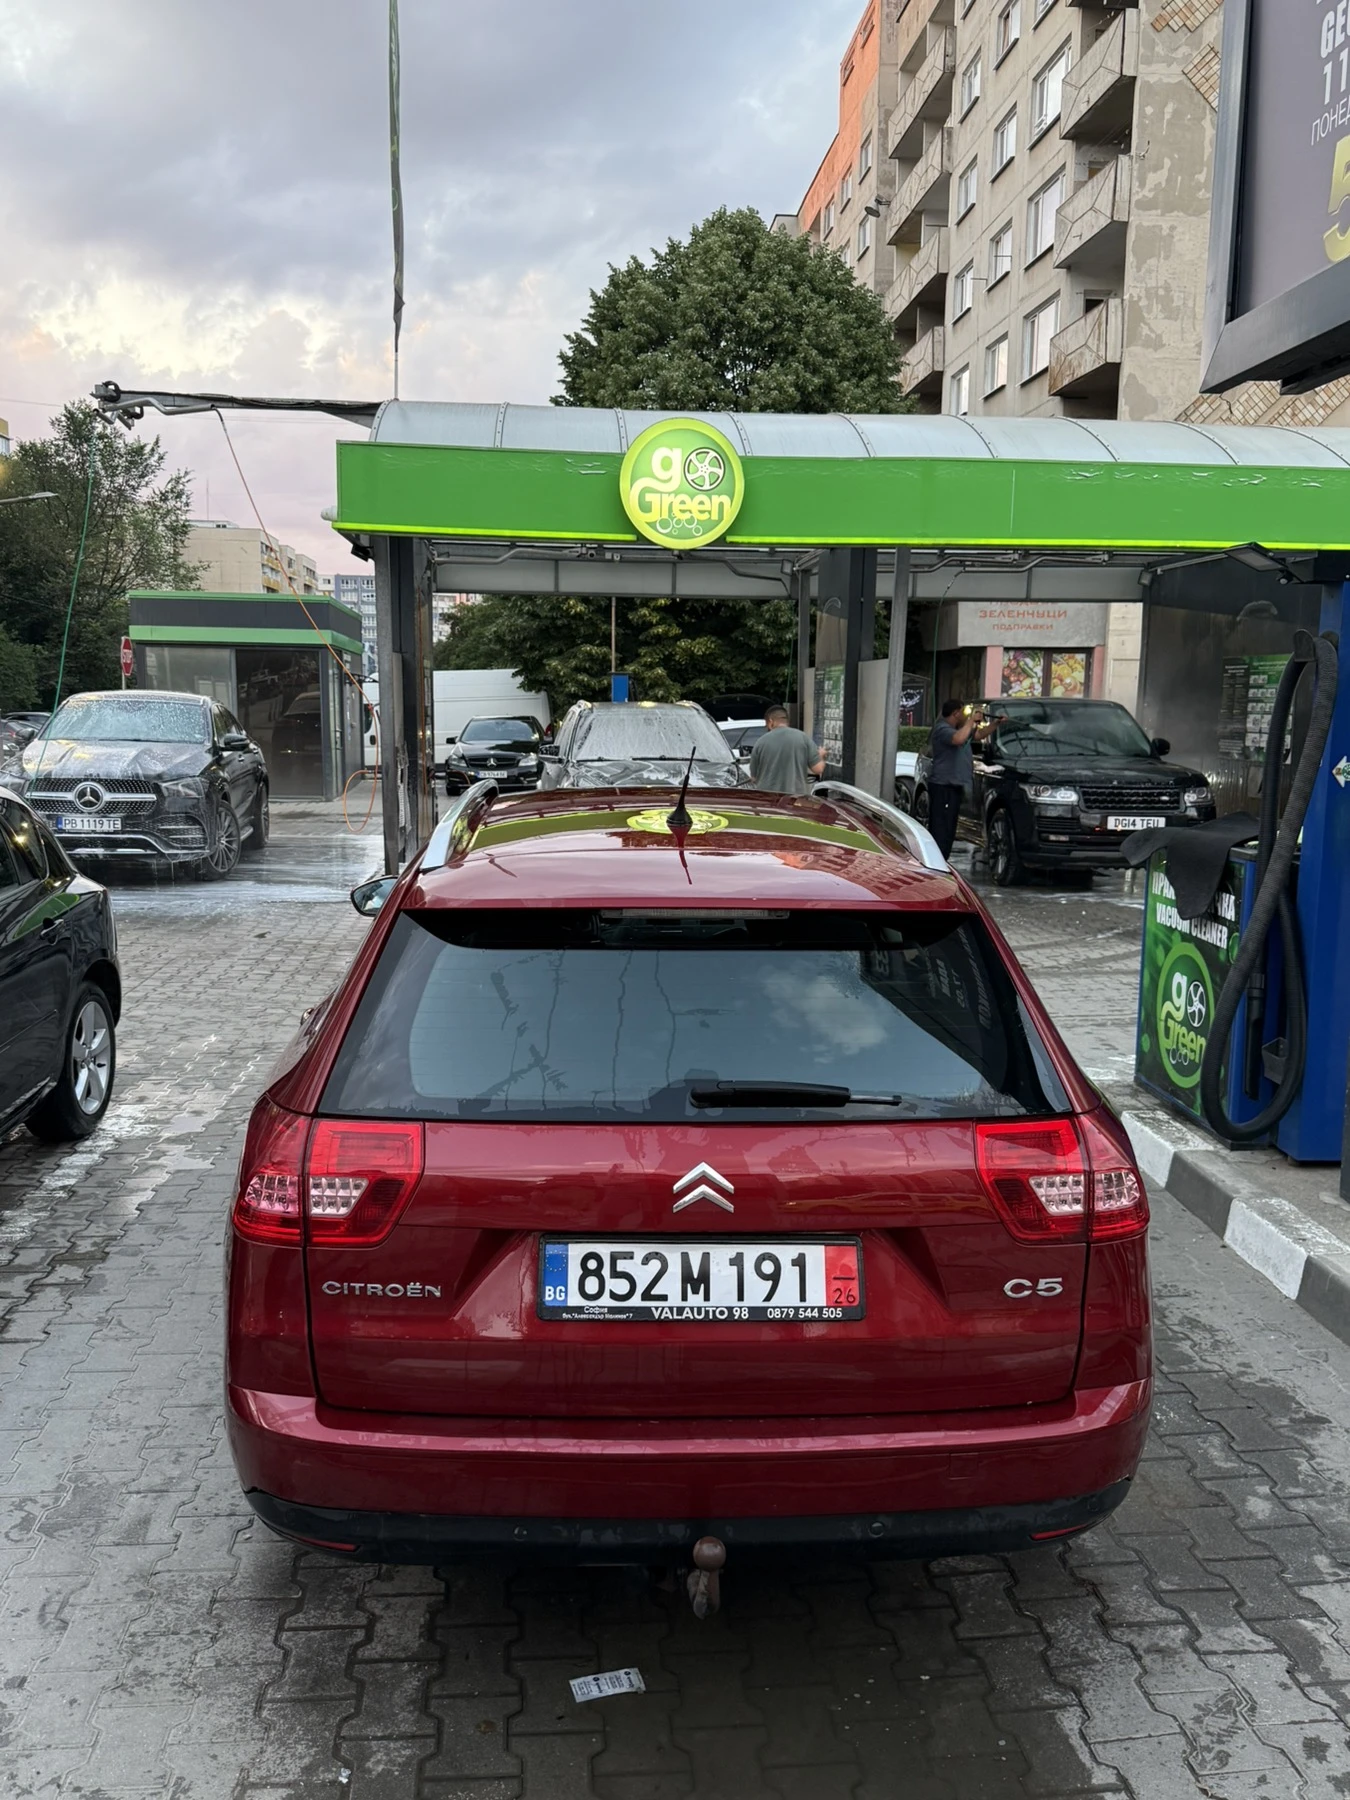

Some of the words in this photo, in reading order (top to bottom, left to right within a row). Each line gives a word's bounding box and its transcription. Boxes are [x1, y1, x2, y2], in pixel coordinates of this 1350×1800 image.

[1320, 0, 1350, 58] GE
[629, 480, 732, 523] Green
[979, 610, 1068, 619] ЗЕЛЕНЧУЦИ
[992, 623, 1054, 631] ПОДПРАВКИ
[80, 818, 105, 829] 1119
[1191, 917, 1228, 950] CLEANER
[1160, 1006, 1206, 1064] Green
[577, 1251, 669, 1302] 852
[728, 1251, 807, 1303] 191
[321, 1281, 441, 1298] CITROËN
[545, 1285, 566, 1300] BG
[833, 1287, 856, 1304] 26
[1003, 1277, 1063, 1299] C5
[651, 1307, 728, 1320] VALAUTO
[732, 1307, 749, 1320] 98
[767, 1307, 795, 1319] 0879
[798, 1307, 818, 1319] 544
[821, 1307, 843, 1319] 505
